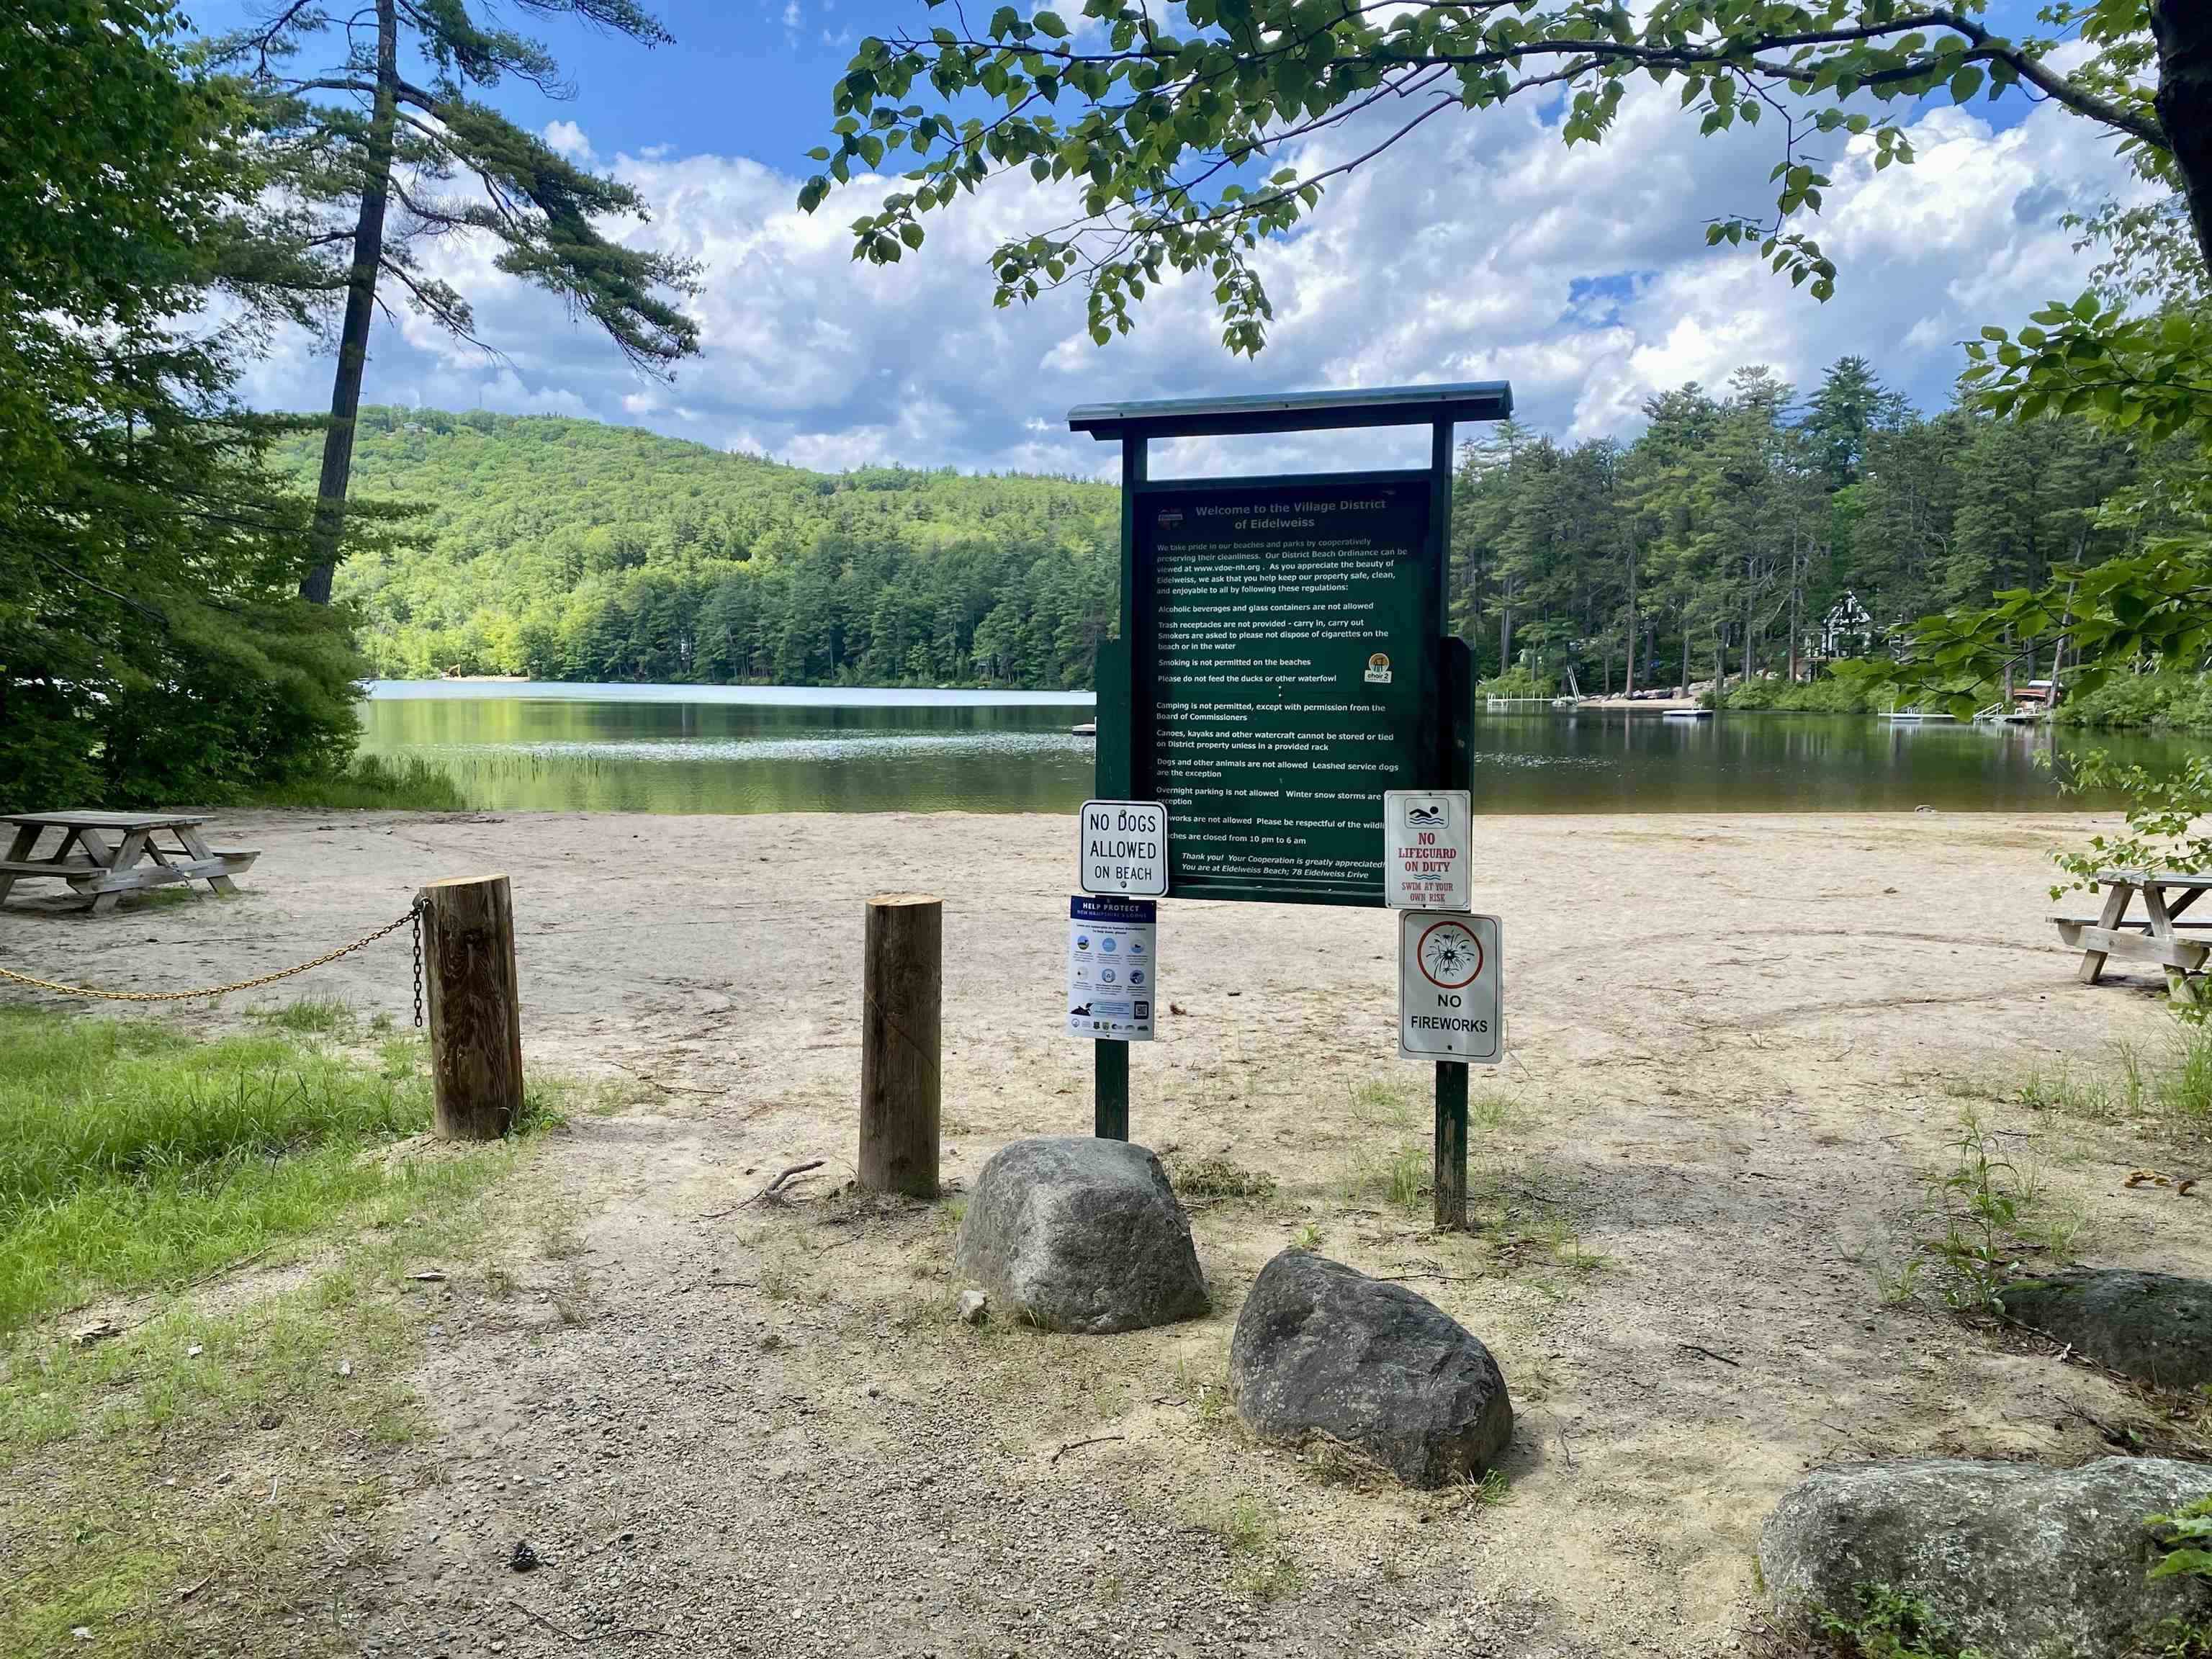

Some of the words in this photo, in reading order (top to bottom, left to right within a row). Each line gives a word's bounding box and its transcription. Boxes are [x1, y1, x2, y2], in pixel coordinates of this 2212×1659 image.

[1195, 505, 1250, 516] Welcome
[1254, 505, 1266, 513] to
[1269, 503, 1290, 513] the
[1294, 502, 1335, 513] Village
[1340, 500, 1385, 510] District
[1235, 520, 1246, 529] of
[1251, 518, 1315, 529] Eidelweiss
[1193, 563, 1260, 572] www.vdoe-nh.org
[1297, 562, 1339, 570] appreciate
[1259, 574, 1276, 583] help
[1314, 573, 1348, 582] property
[1172, 586, 1208, 595] enjoyable
[1230, 585, 1240, 594] by
[1241, 585, 1276, 593] following
[1192, 605, 1231, 613] beverages
[1249, 604, 1268, 613] glass
[1252, 620, 1285, 629] provided
[1280, 631, 1309, 639] dispose
[1214, 658, 1251, 667] permitted
[1187, 730, 1213, 739] kayaks
[1197, 742, 1230, 750] property
[1274, 743, 1309, 752] provided
[1185, 770, 1221, 779] exception
[1195, 788, 1223, 796] parking
[1090, 814, 1110, 830] NO
[1118, 814, 1156, 832] DOGS
[1295, 819, 1335, 829] respectful
[1418, 832, 1436, 845] NO
[1090, 840, 1156, 859] ALLOWED
[1398, 848, 1457, 858] LIFEGUARD
[1247, 855, 1295, 865] Cooperation
[1305, 857, 1333, 866] greatly
[1221, 864, 1261, 873] Eidelweiss
[1304, 868, 1345, 877] Eidelweiss
[1405, 861, 1418, 871] ON
[1422, 862, 1450, 872] DUTY
[1094, 866, 1110, 878] ON
[1116, 866, 1151, 881] BEACH
[1401, 882, 1421, 891] SWIM
[1424, 882, 1434, 891] AT
[1435, 883, 1453, 891] YOUR
[1410, 893, 1426, 902] OWN
[1438, 994, 1462, 1008] NO
[1411, 1016, 1488, 1033] FIREWORKS
